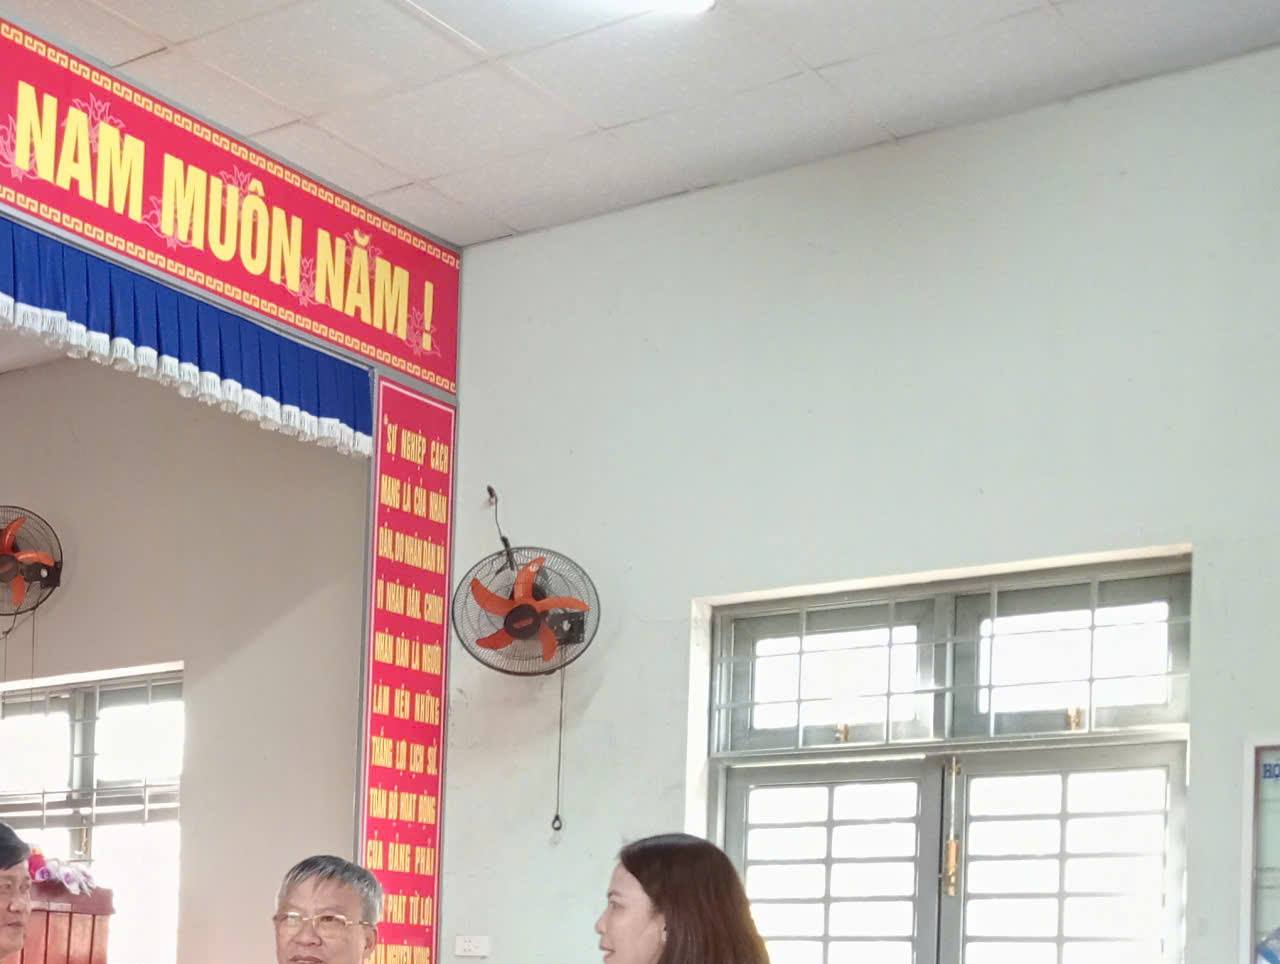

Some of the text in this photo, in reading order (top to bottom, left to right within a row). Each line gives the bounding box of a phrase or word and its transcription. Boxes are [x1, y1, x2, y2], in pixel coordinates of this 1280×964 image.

[14, 80, 145, 223] NAM
[160, 152, 302, 292] MUÔN
[314, 227, 410, 340] NĂM
[422, 281, 434, 351] !
